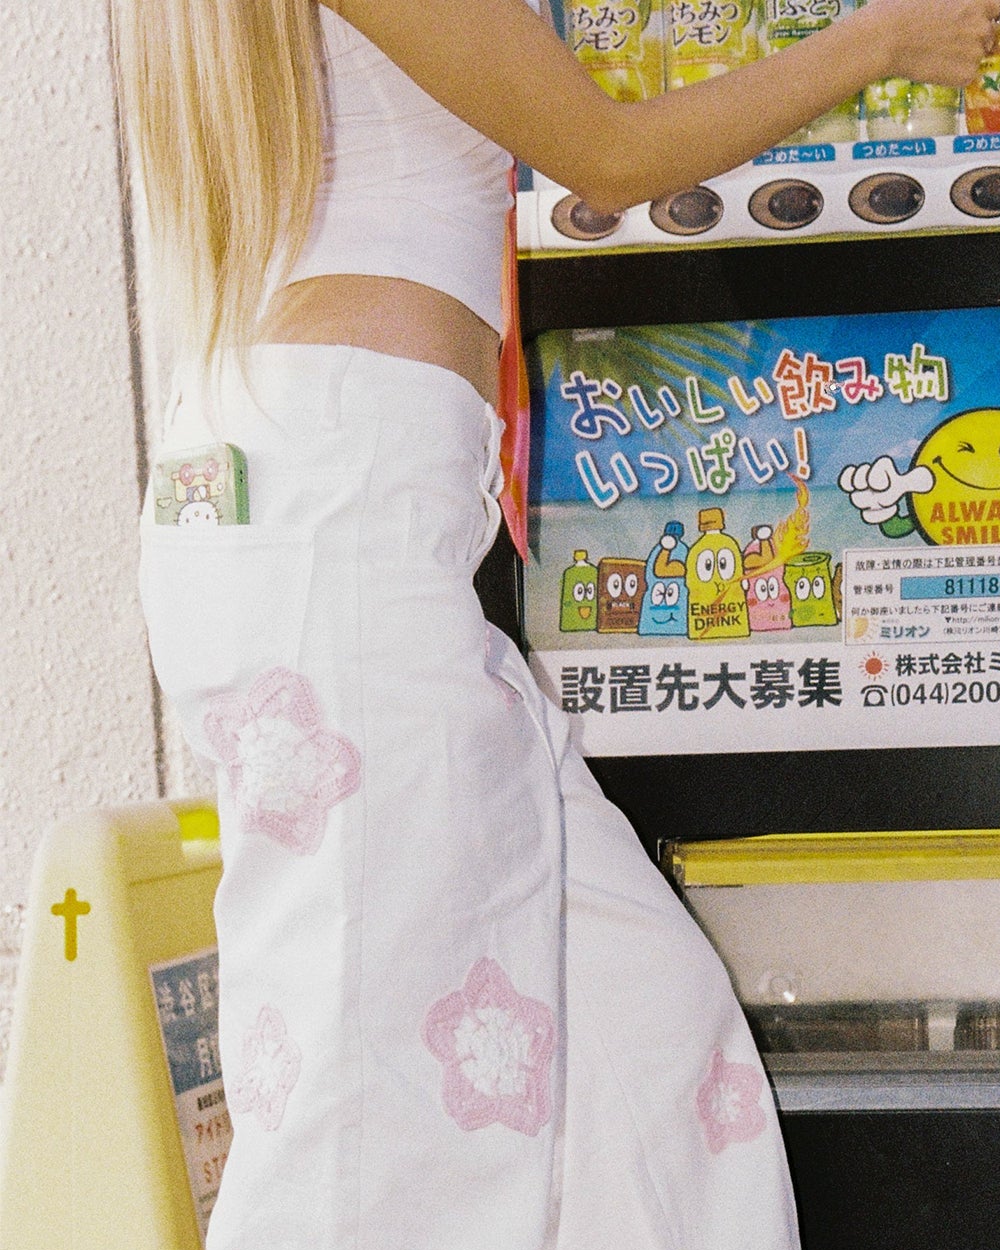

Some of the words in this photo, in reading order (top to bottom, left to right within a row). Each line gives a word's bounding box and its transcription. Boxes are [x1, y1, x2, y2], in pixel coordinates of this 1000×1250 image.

[572, 6, 636, 33] ちみつ
[672, 24, 730, 47] レモン
[561, 343, 949, 439] おいしい飲み物
[853, 583, 894, 595] 管理番号
[690, 601, 745, 617] ENERGY
[694, 615, 742, 631] DRINK
[880, 625, 931, 639] ミリオン
[561, 657, 843, 714] 設置先大募集
